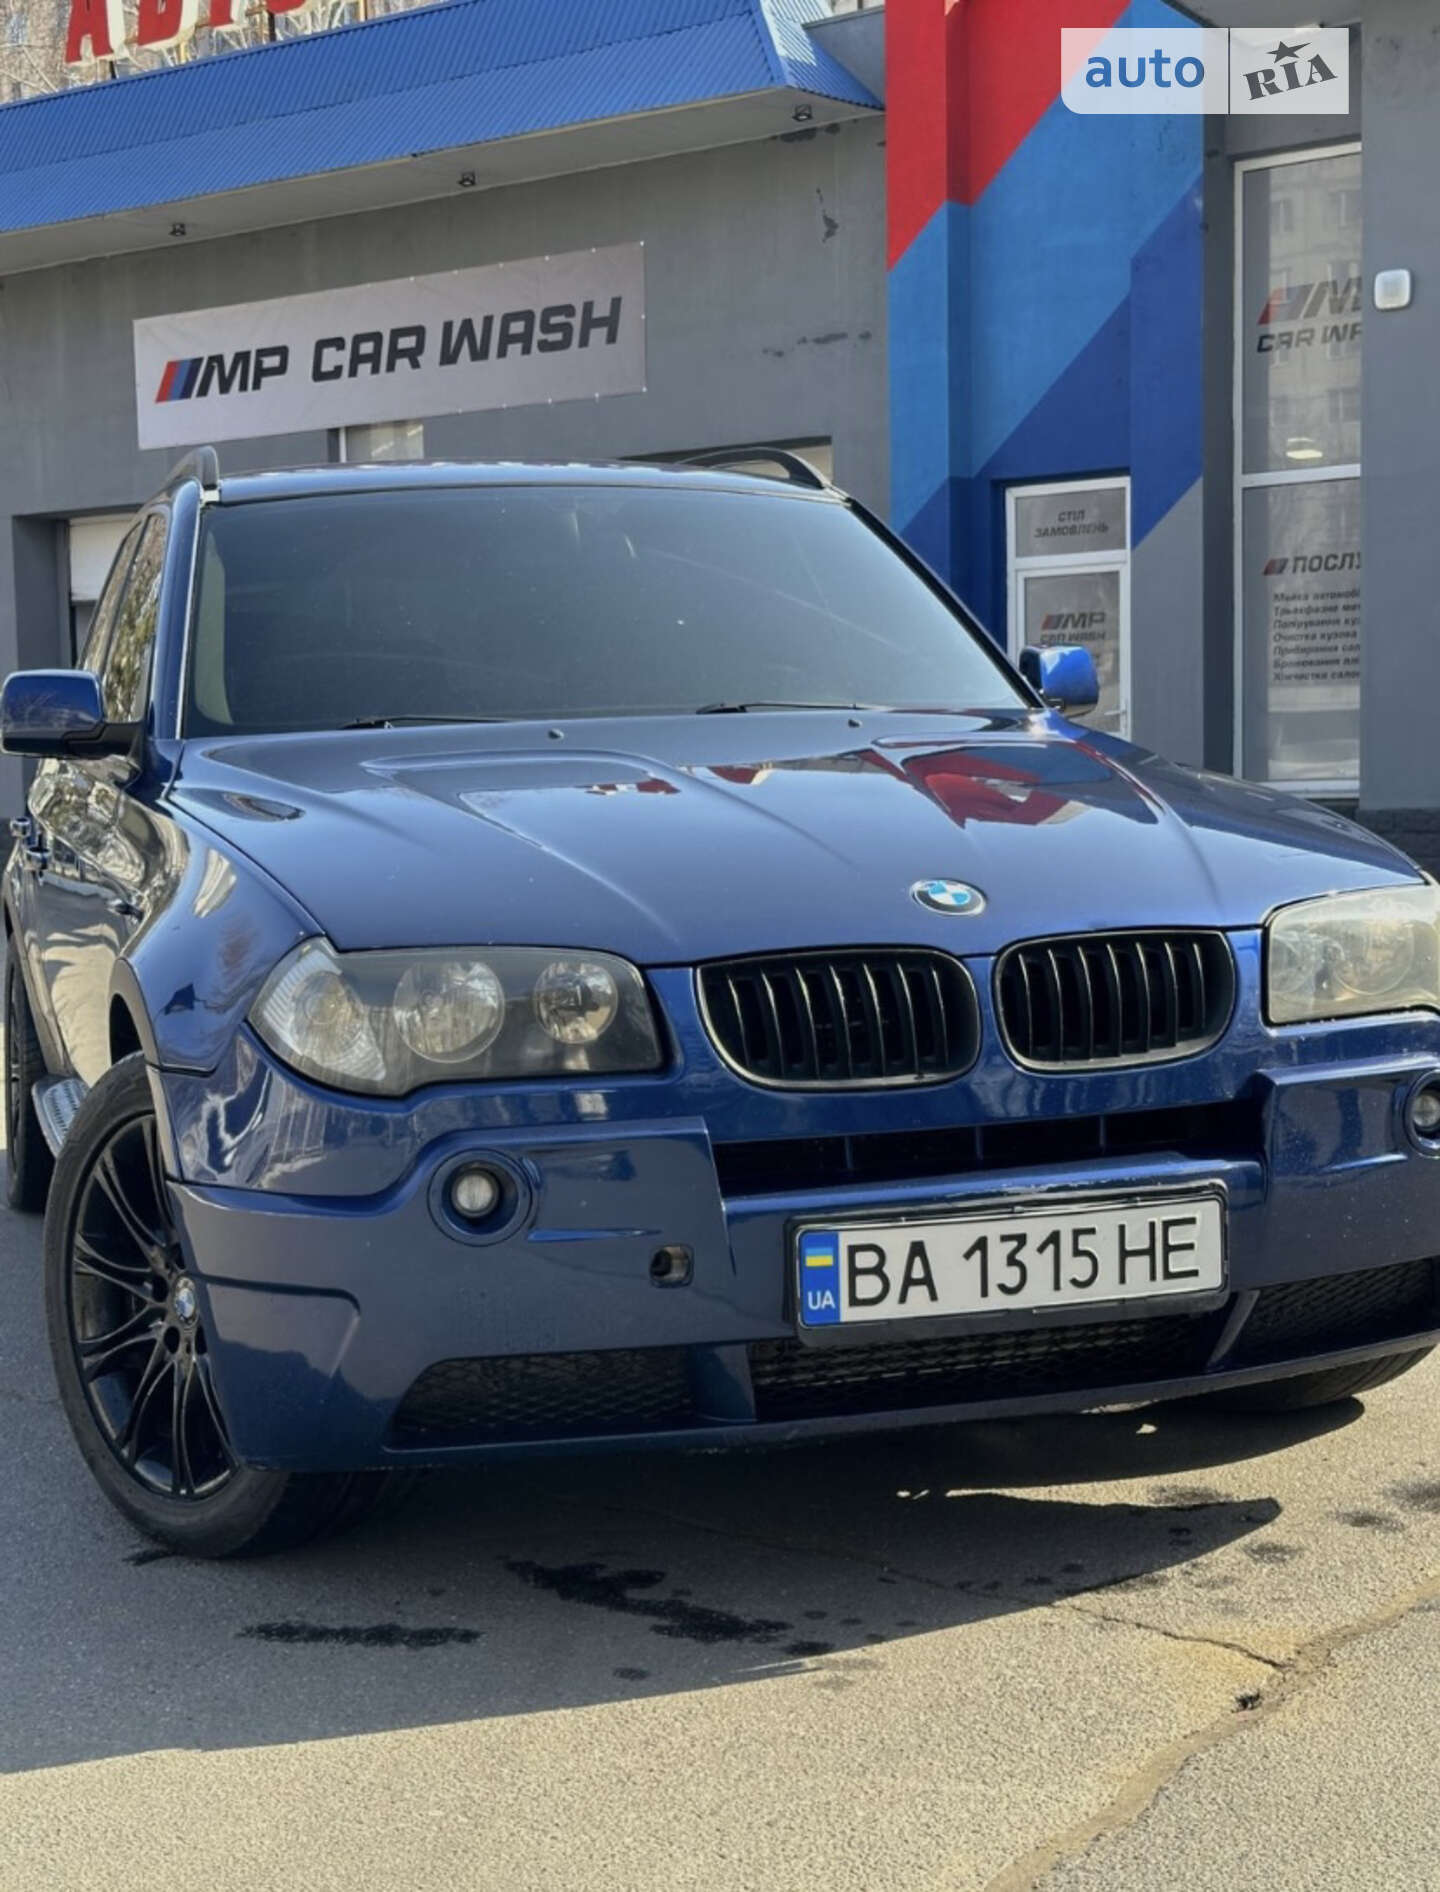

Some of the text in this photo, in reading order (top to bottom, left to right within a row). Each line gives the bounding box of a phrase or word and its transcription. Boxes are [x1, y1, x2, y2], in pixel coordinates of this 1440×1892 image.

[311, 325, 426, 383] CAR
[438, 296, 622, 366] WASH
[1257, 328, 1315, 353] CAR
[1058, 509, 1085, 522] СТІЛ
[1034, 523, 1109, 538] ЗАМОВЛЕНЬ
[1067, 631, 1106, 641] WASH
[1320, 630, 1357, 641] кузова
[847, 1216, 1199, 1308] BA 1315 HE
[807, 1291, 836, 1311] UA
